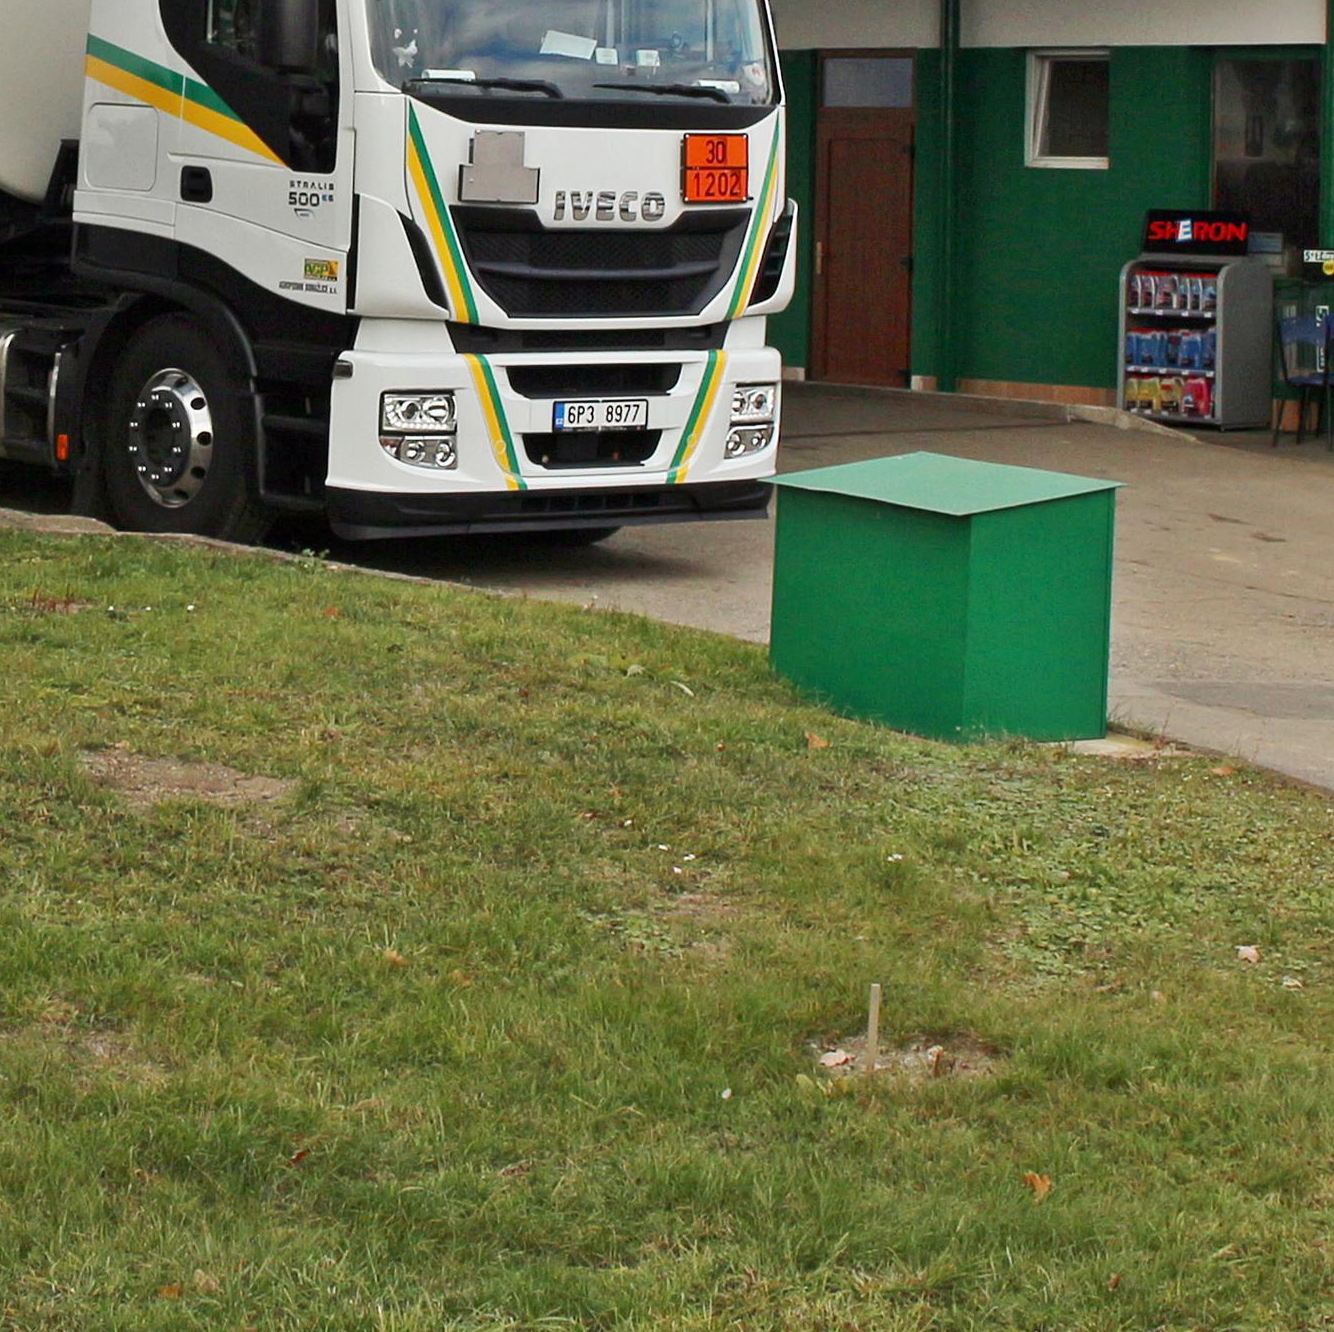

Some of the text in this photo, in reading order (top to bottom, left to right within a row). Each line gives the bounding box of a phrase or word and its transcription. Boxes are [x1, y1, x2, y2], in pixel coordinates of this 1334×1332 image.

[705, 139, 726, 164] 30
[289, 180, 334, 191] STRALIS
[693, 171, 740, 197] 1202
[288, 192, 320, 207] 500
[554, 190, 665, 221] IVECO
[1148, 218, 1248, 242] SHERON
[568, 405, 594, 424] 6P3
[605, 404, 640, 423] 8977
